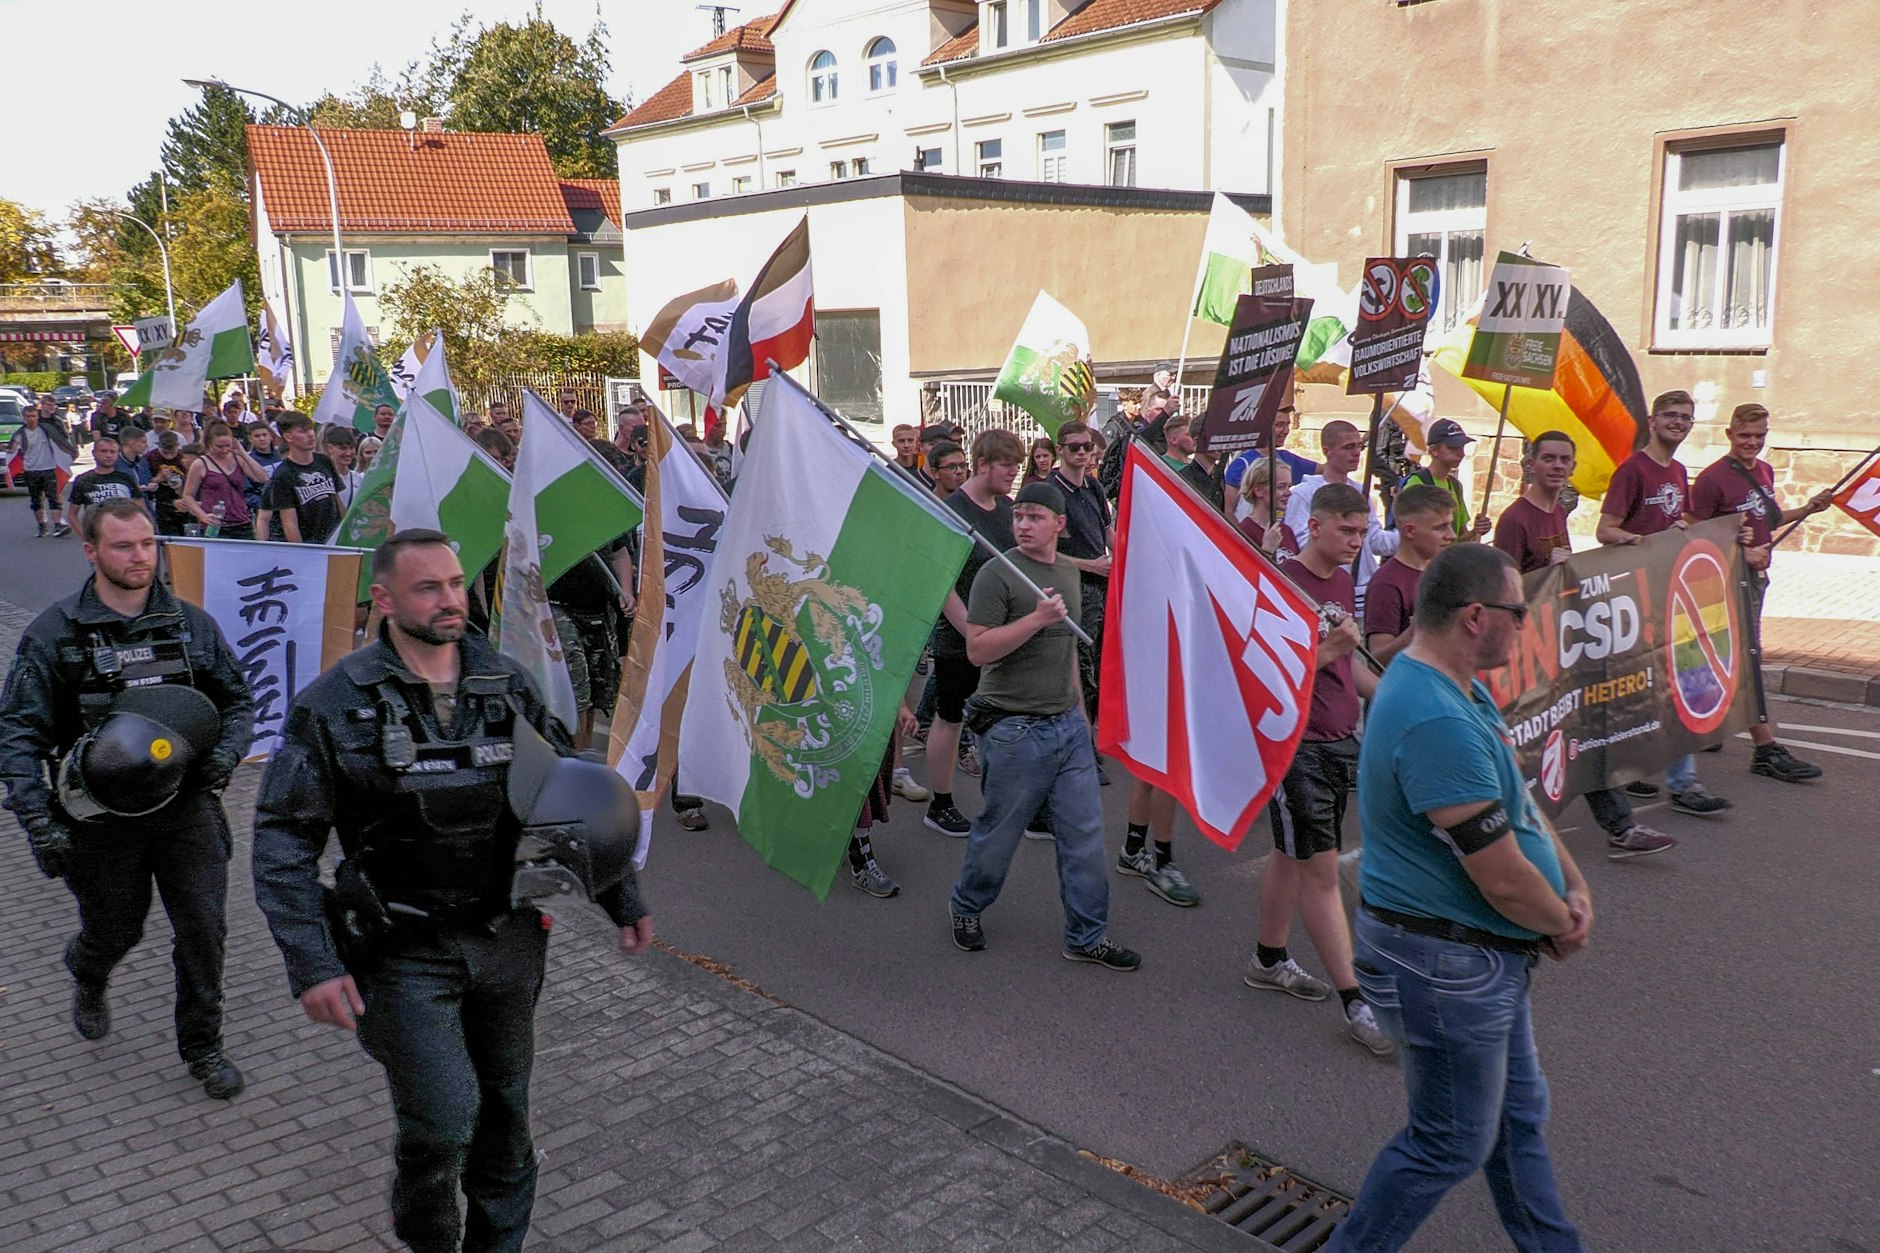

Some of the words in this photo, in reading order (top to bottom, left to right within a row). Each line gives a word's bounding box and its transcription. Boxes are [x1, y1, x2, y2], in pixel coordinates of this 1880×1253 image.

[1255, 275, 1293, 296] DEUTSCHLANDS
[1489, 281, 1527, 319] XX
[1229, 320, 1302, 356] NATIONALISMUS
[1354, 329, 1422, 363] RAUMORIENTIERTE
[1227, 357, 1245, 377] IST
[1243, 353, 1260, 373] DIE
[1259, 342, 1296, 368] LÖSUNG!
[1353, 346, 1422, 379] VOLKSWIRTSCHAFT
[88, 489, 119, 498] WHITE
[97, 482, 117, 492] THE
[1580, 572, 1611, 600] ZUM
[1584, 666, 1654, 707] HETERO!
